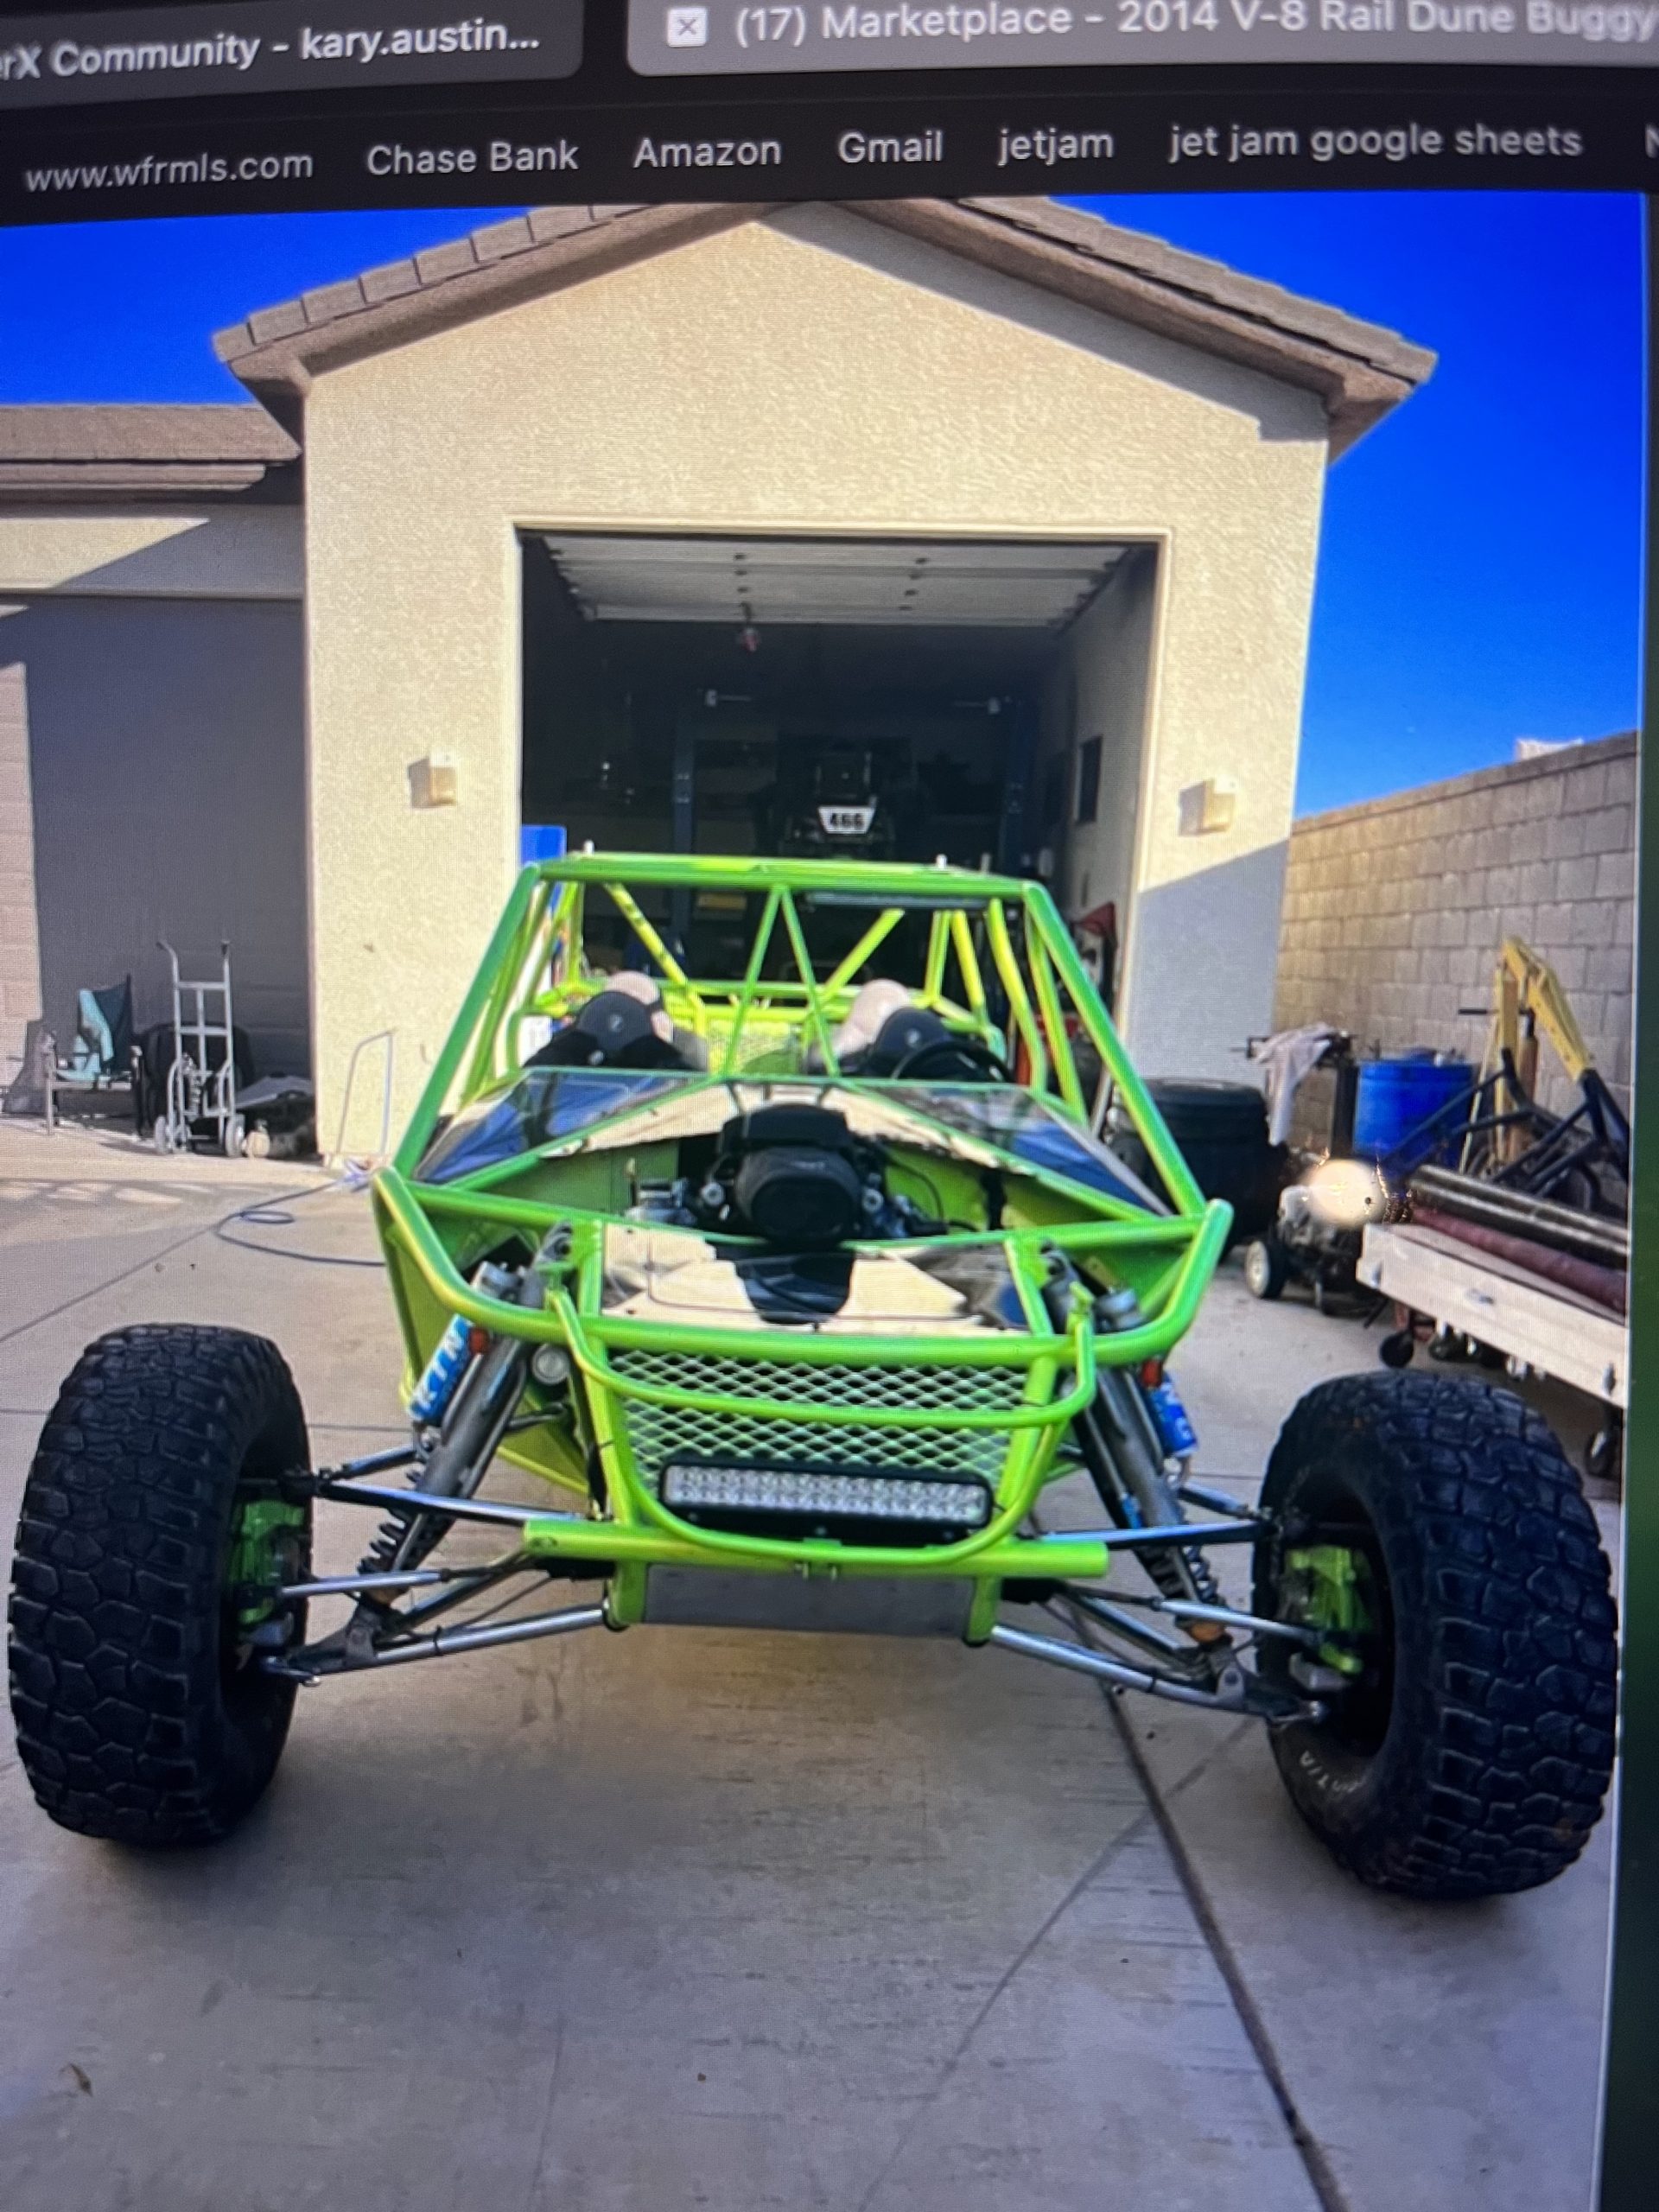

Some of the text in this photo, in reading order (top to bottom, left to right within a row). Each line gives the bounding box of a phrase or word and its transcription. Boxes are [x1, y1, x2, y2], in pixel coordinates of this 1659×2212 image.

[737, 7, 806, 47] (17)
[823, 2, 1072, 42] Marketplace
[1118, 0, 1218, 33] 2014
[1230, 0, 1306, 31] V-8
[1320, 0, 1394, 31] Rail
[1408, 0, 1515, 33] Dune
[1527, 0, 1659, 41] Buggy
[0, 46, 41, 79] rX
[51, 33, 261, 76] Community
[301, 17, 540, 63] kary.austin...
[367, 140, 579, 175] Chase Bank
[633, 137, 782, 168] Amazon
[838, 130, 944, 163] Gmail
[997, 127, 1114, 167] jetjam
[1168, 123, 1582, 163] jet jam google sheets
[26, 153, 313, 191] www.wfrmls.com
